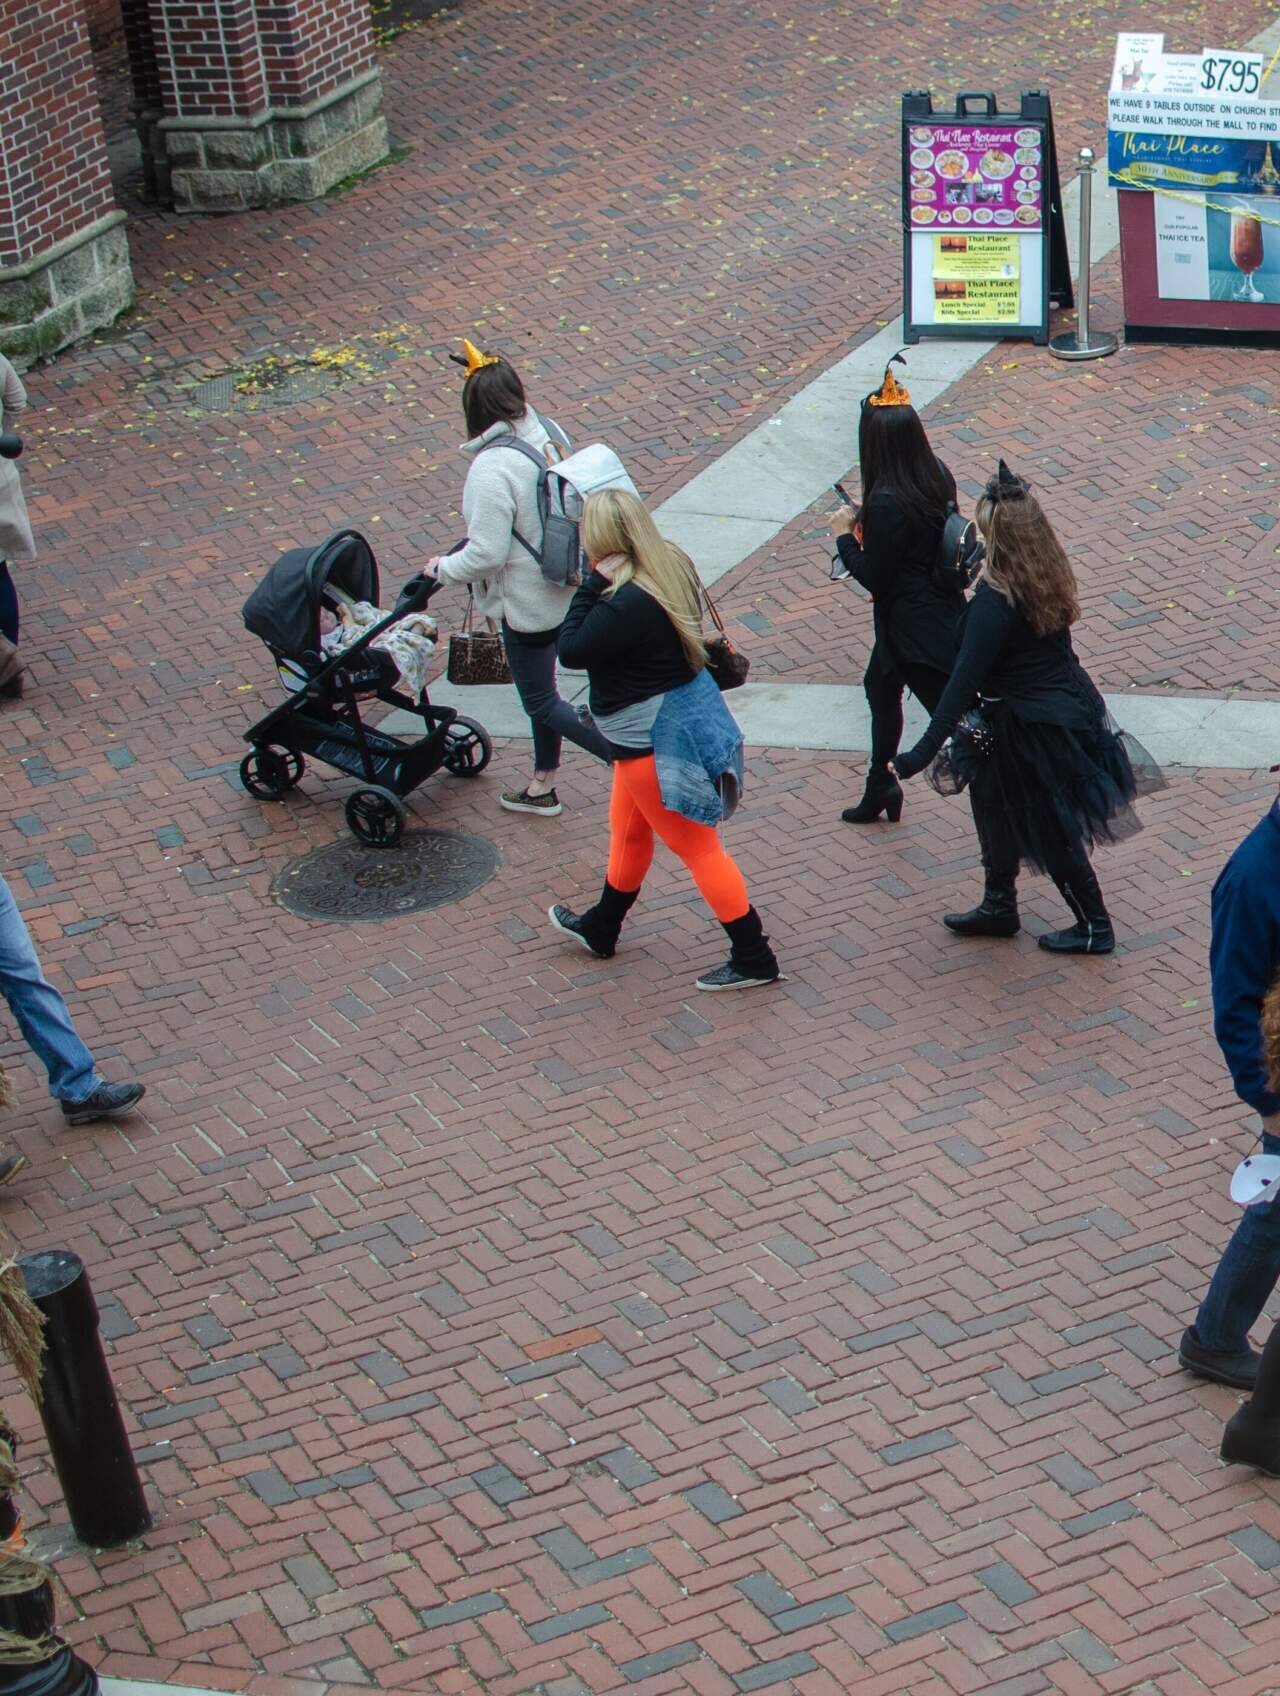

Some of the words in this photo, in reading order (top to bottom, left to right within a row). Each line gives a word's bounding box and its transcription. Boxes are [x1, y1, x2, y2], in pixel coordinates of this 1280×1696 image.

[1201, 58, 1261, 94] $7.95
[1109, 99, 1120, 107] WE
[1124, 100, 1143, 109] HAVE
[1154, 101, 1181, 111] TABLES
[1184, 102, 1215, 113] OUTSIDE
[1220, 104, 1231, 113] ON
[1234, 106, 1266, 116] CHURCH
[1113, 113, 1140, 124] PLEASE
[1143, 115, 1163, 125] WALK
[1167, 117, 1203, 128] THROUGH
[1206, 119, 1220, 129] THE
[1224, 120, 1243, 130] MALL
[1246, 121, 1257, 131] TO
[1259, 122, 1278, 132] FIND
[1114, 132, 1161, 158] Thai
[1162, 135, 1225, 156] Place
[968, 280, 987, 288] Thai
[990, 280, 1015, 288] Place
